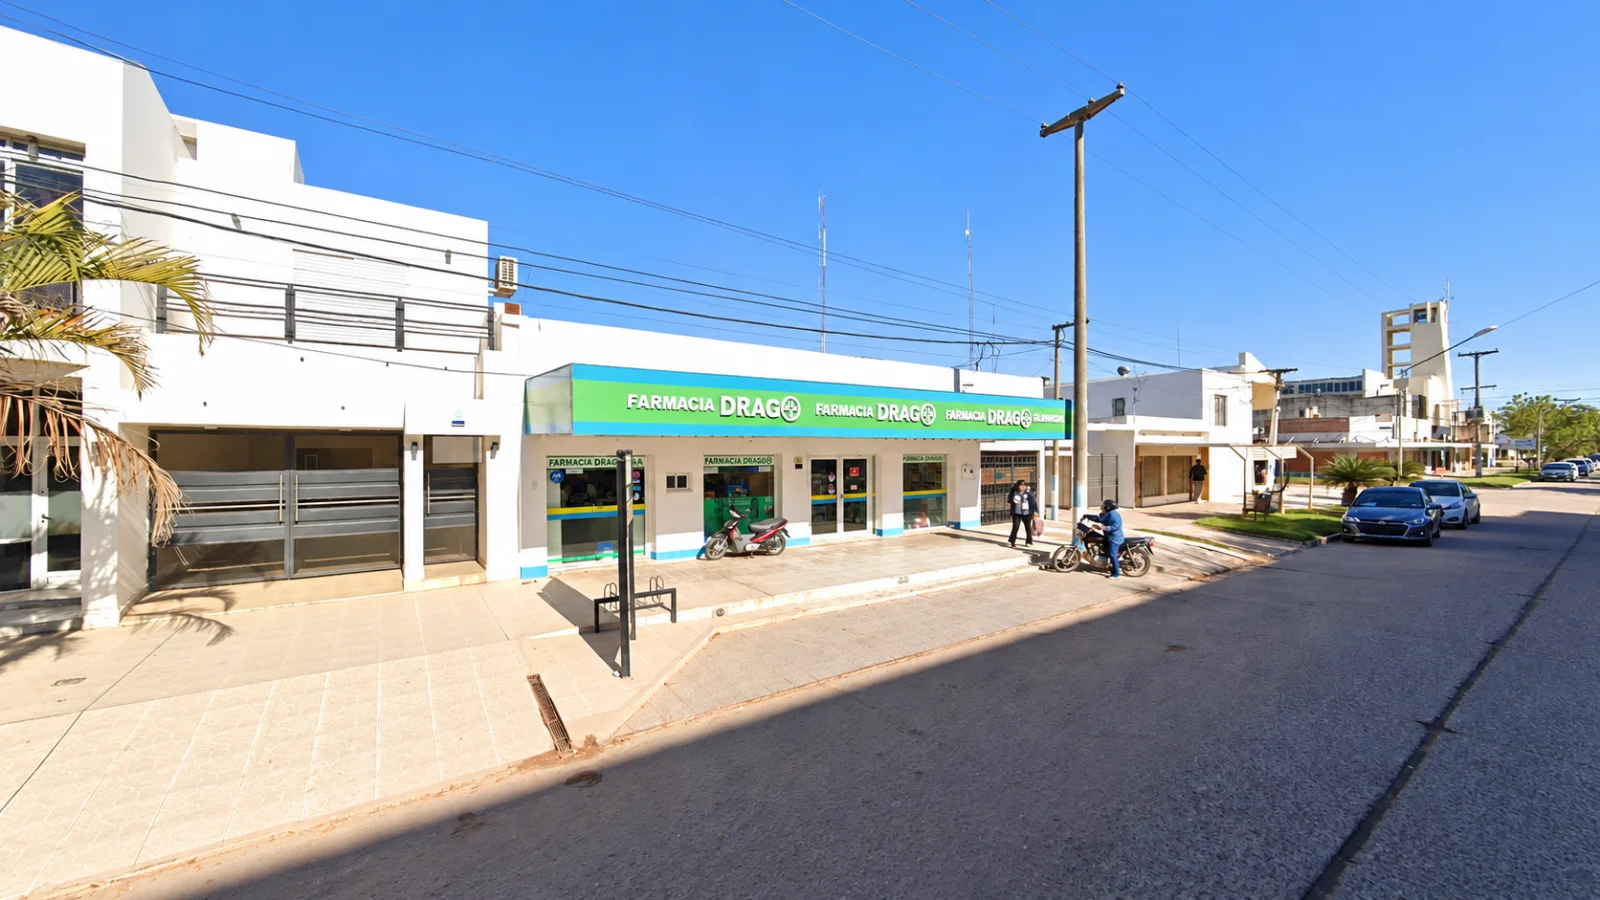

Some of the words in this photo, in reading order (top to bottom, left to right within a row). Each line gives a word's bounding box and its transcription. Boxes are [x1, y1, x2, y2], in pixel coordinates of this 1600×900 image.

[627, 393, 715, 412] FARMACIA
[719, 395, 801, 422] DRAGO
[815, 403, 874, 418] FARMACIA
[876, 403, 936, 427] DRAGO
[945, 409, 986, 422] FARMACIA
[987, 408, 1032, 428] DRAGO
[549, 458, 592, 467] FARMACIA
